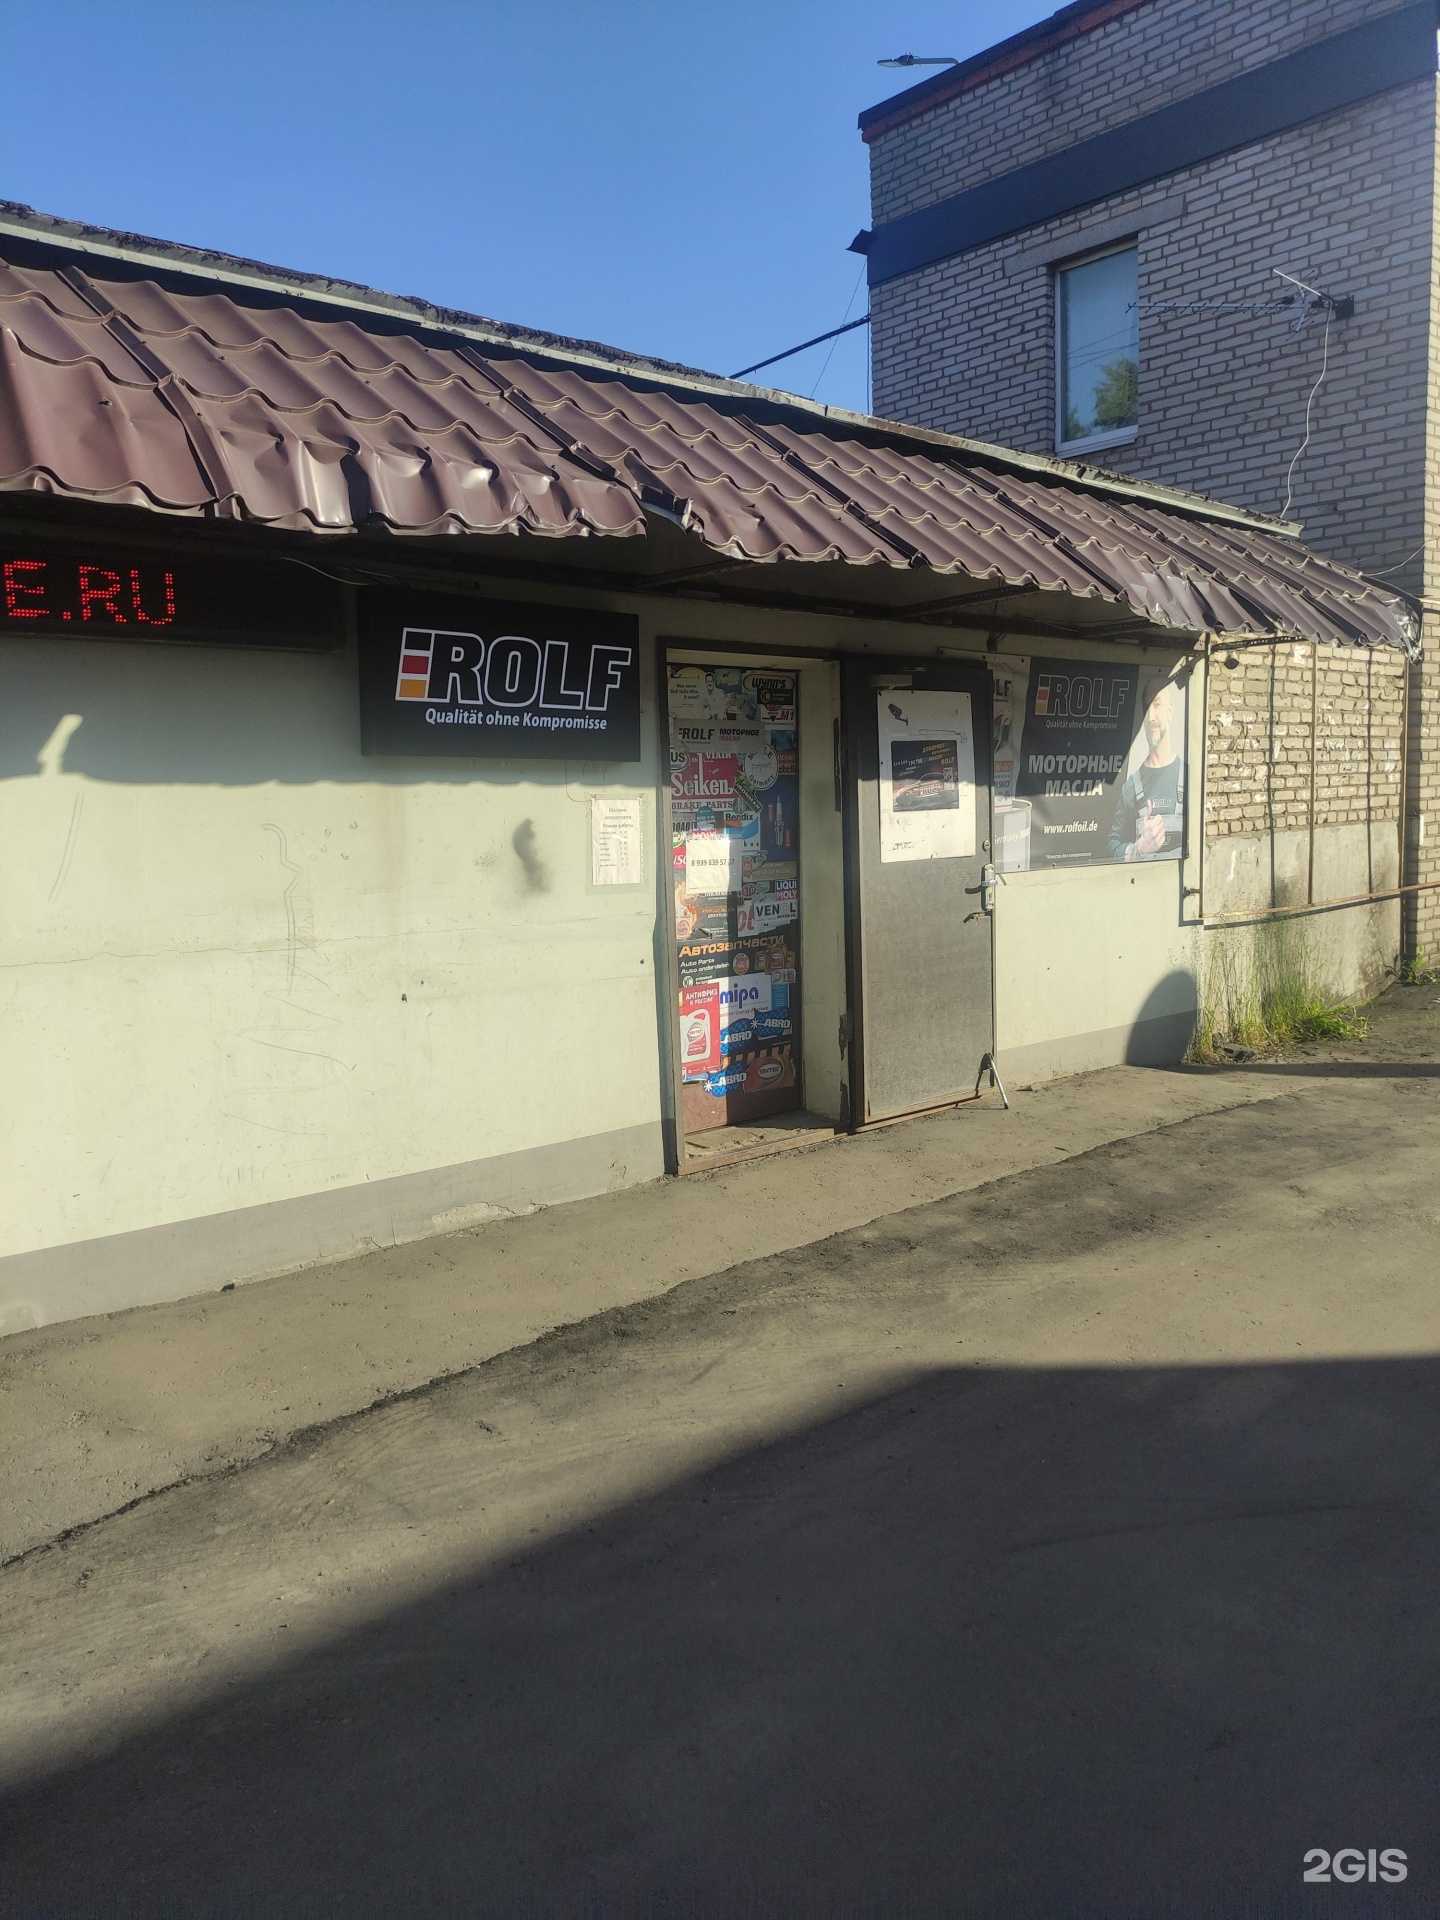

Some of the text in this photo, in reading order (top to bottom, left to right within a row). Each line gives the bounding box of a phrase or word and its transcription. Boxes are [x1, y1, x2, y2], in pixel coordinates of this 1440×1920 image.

[425, 629, 632, 712] ROLF
[1045, 674, 1130, 718] ROLF
[425, 707, 608, 731] Qualität ohne Kompromisse
[682, 727, 715, 740] ROLF
[1028, 754, 1124, 774] МОТОРНЫЕ
[1044, 778, 1104, 797] МАСЛА
[704, 800, 734, 809] PARTS
[1043, 818, 1098, 834] www.rolfoil.de
[776, 880, 797, 890] LIQUI
[776, 890, 797, 900] MOLY
[755, 901, 797, 917] VENL
[680, 960, 698, 968] Auto
[680, 967, 698, 975] Auto
[720, 984, 759, 1009] mipa
[764, 1018, 791, 1029] ABRO
[725, 1030, 752, 1042] ABRO
[720, 1072, 747, 1086] ABRO
